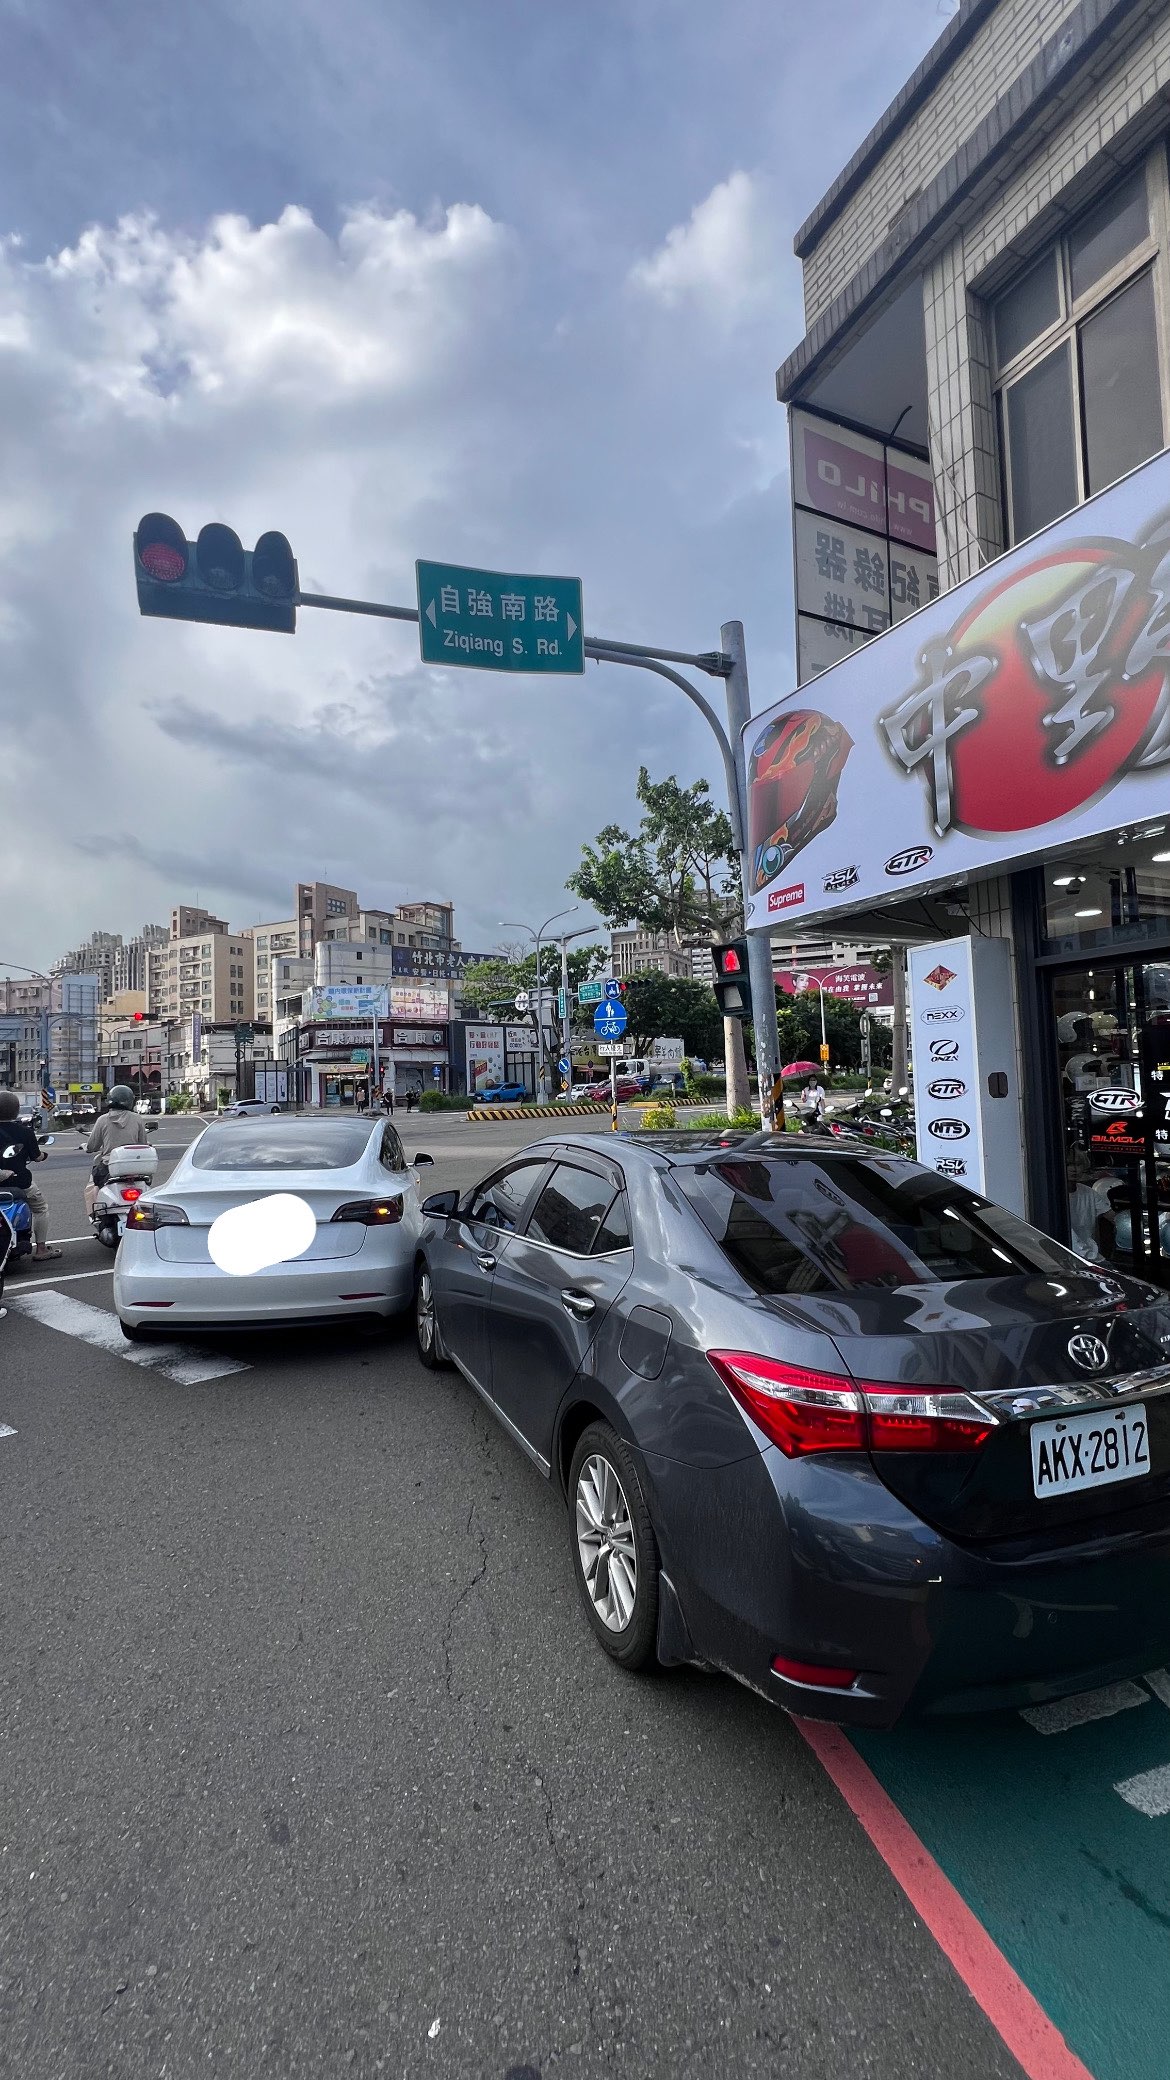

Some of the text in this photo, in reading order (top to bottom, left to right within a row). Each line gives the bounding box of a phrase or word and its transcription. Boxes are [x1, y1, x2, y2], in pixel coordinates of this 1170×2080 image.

[440, 584, 560, 622] 自強南路
[443, 629, 563, 657] Ziqiang S. Rd.
[888, 849, 930, 869] GTR
[822, 865, 861, 885] RSV
[768, 888, 803, 907] Supreme
[931, 1055, 958, 1063] ONZA
[931, 1084, 962, 1094] GTR
[1093, 1093, 1137, 1107] GTR
[934, 1122, 963, 1134] NTS
[1091, 1135, 1145, 1144] BILMOLA
[934, 1158, 967, 1170] RSV
